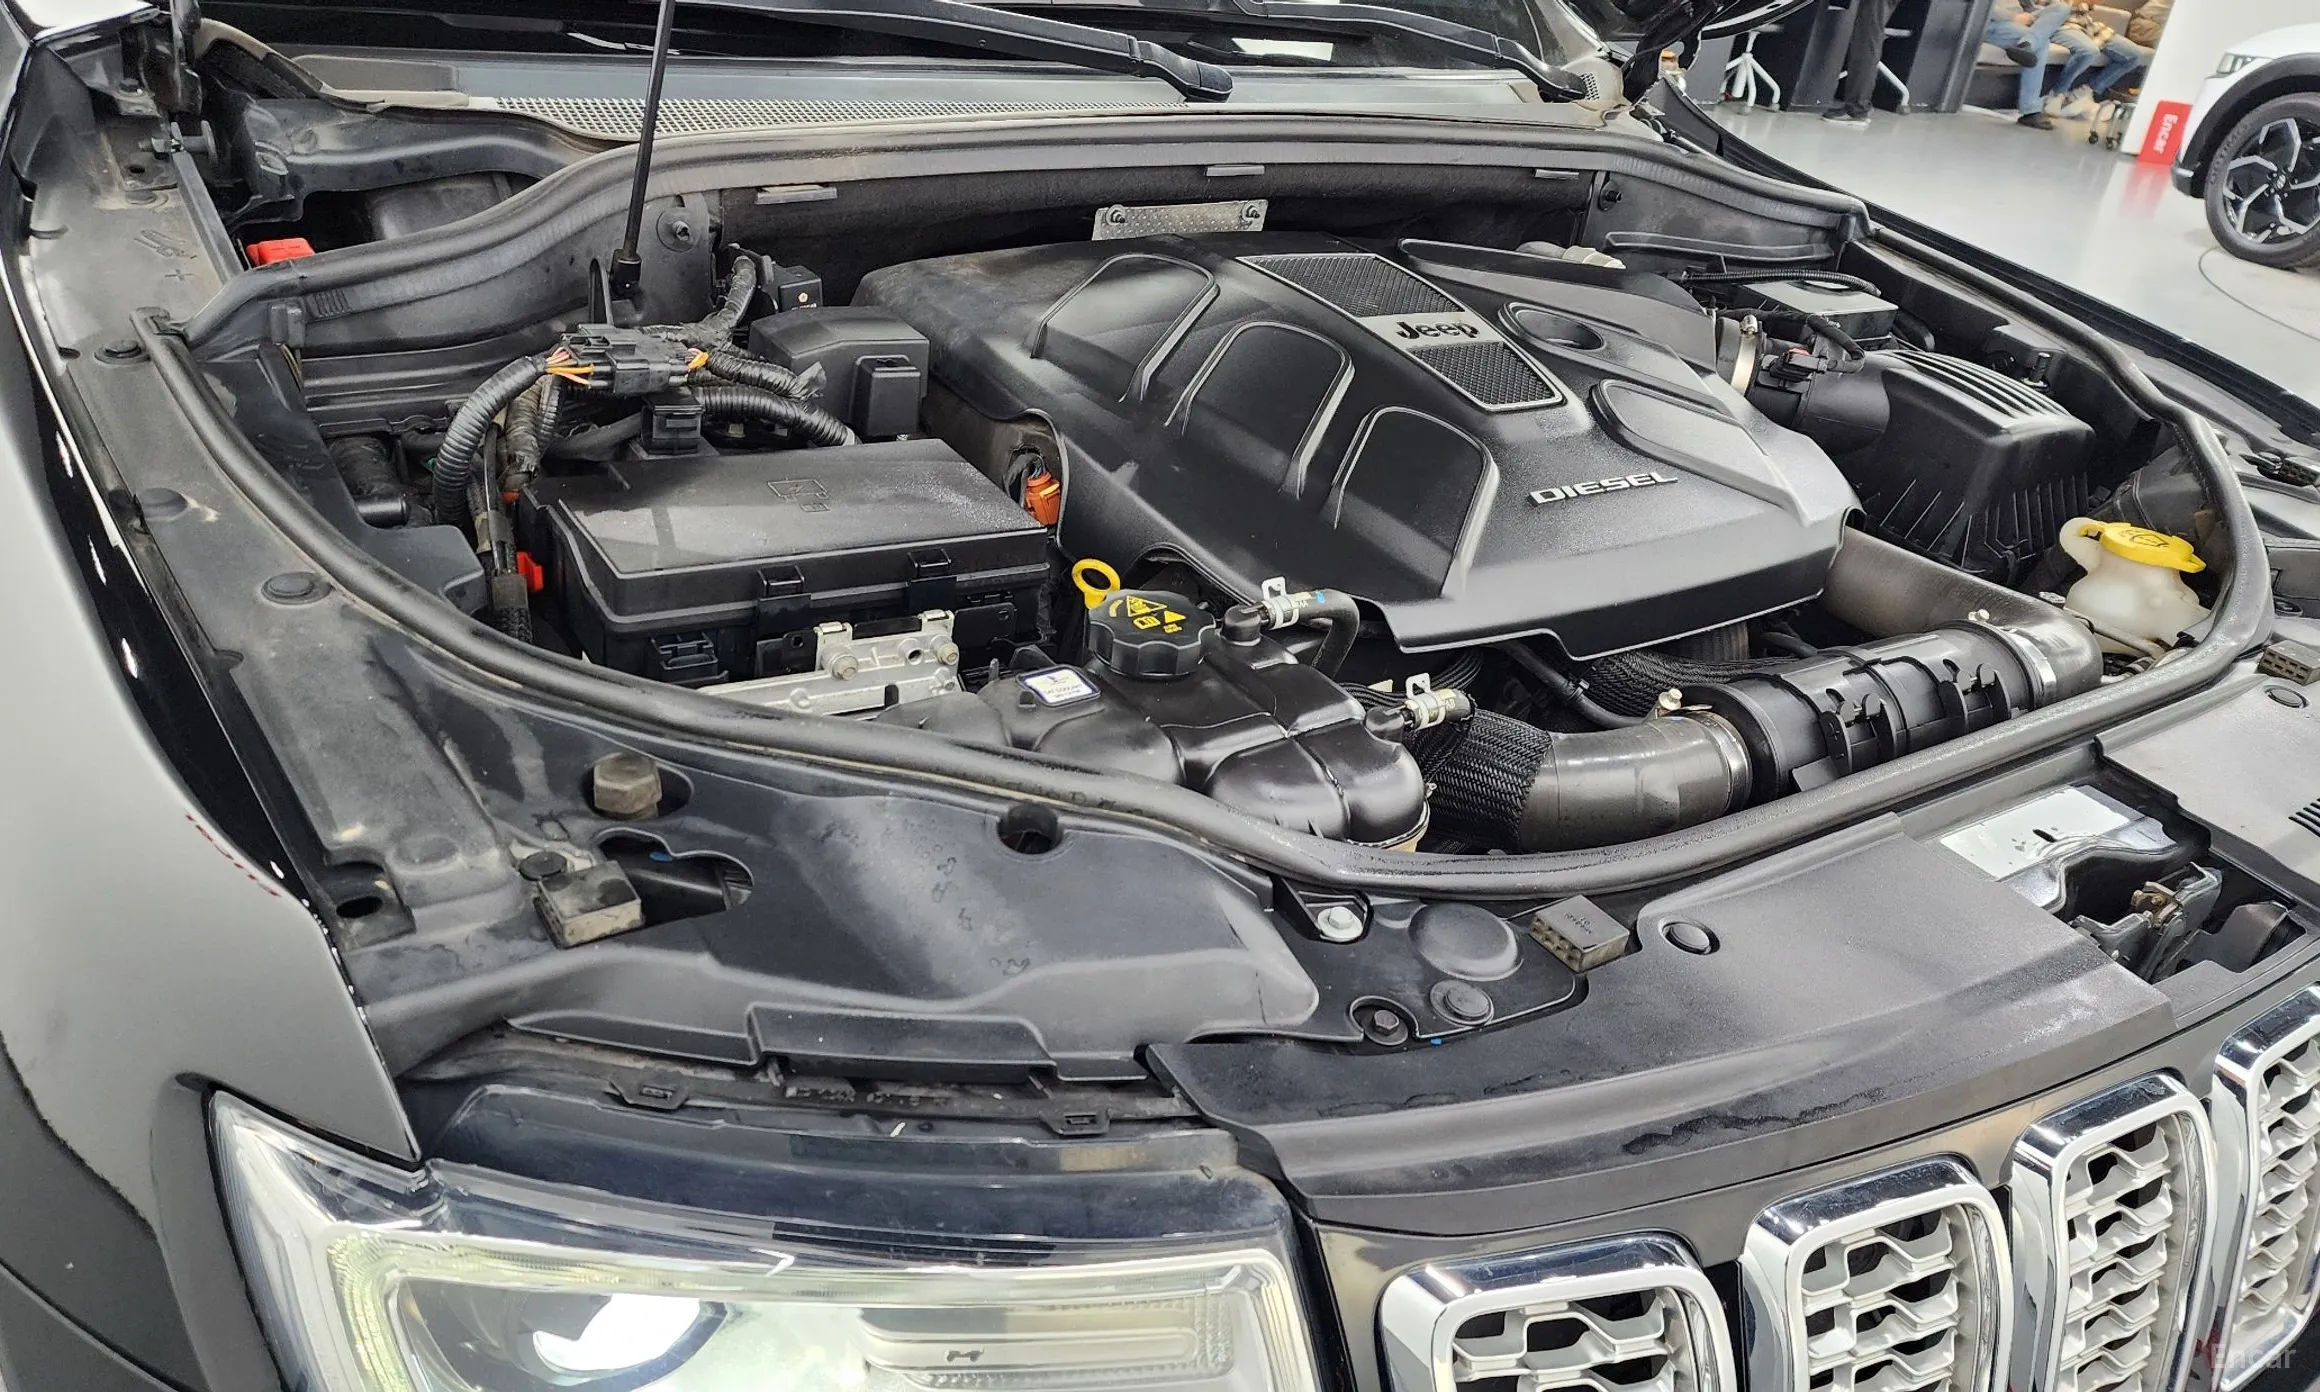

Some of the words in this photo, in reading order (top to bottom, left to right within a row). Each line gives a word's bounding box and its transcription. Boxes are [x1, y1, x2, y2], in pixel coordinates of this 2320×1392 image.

[2153, 113, 2178, 154] Encar
[1395, 321, 1479, 339] Jeep
[1529, 471, 1679, 505] DIESEL
